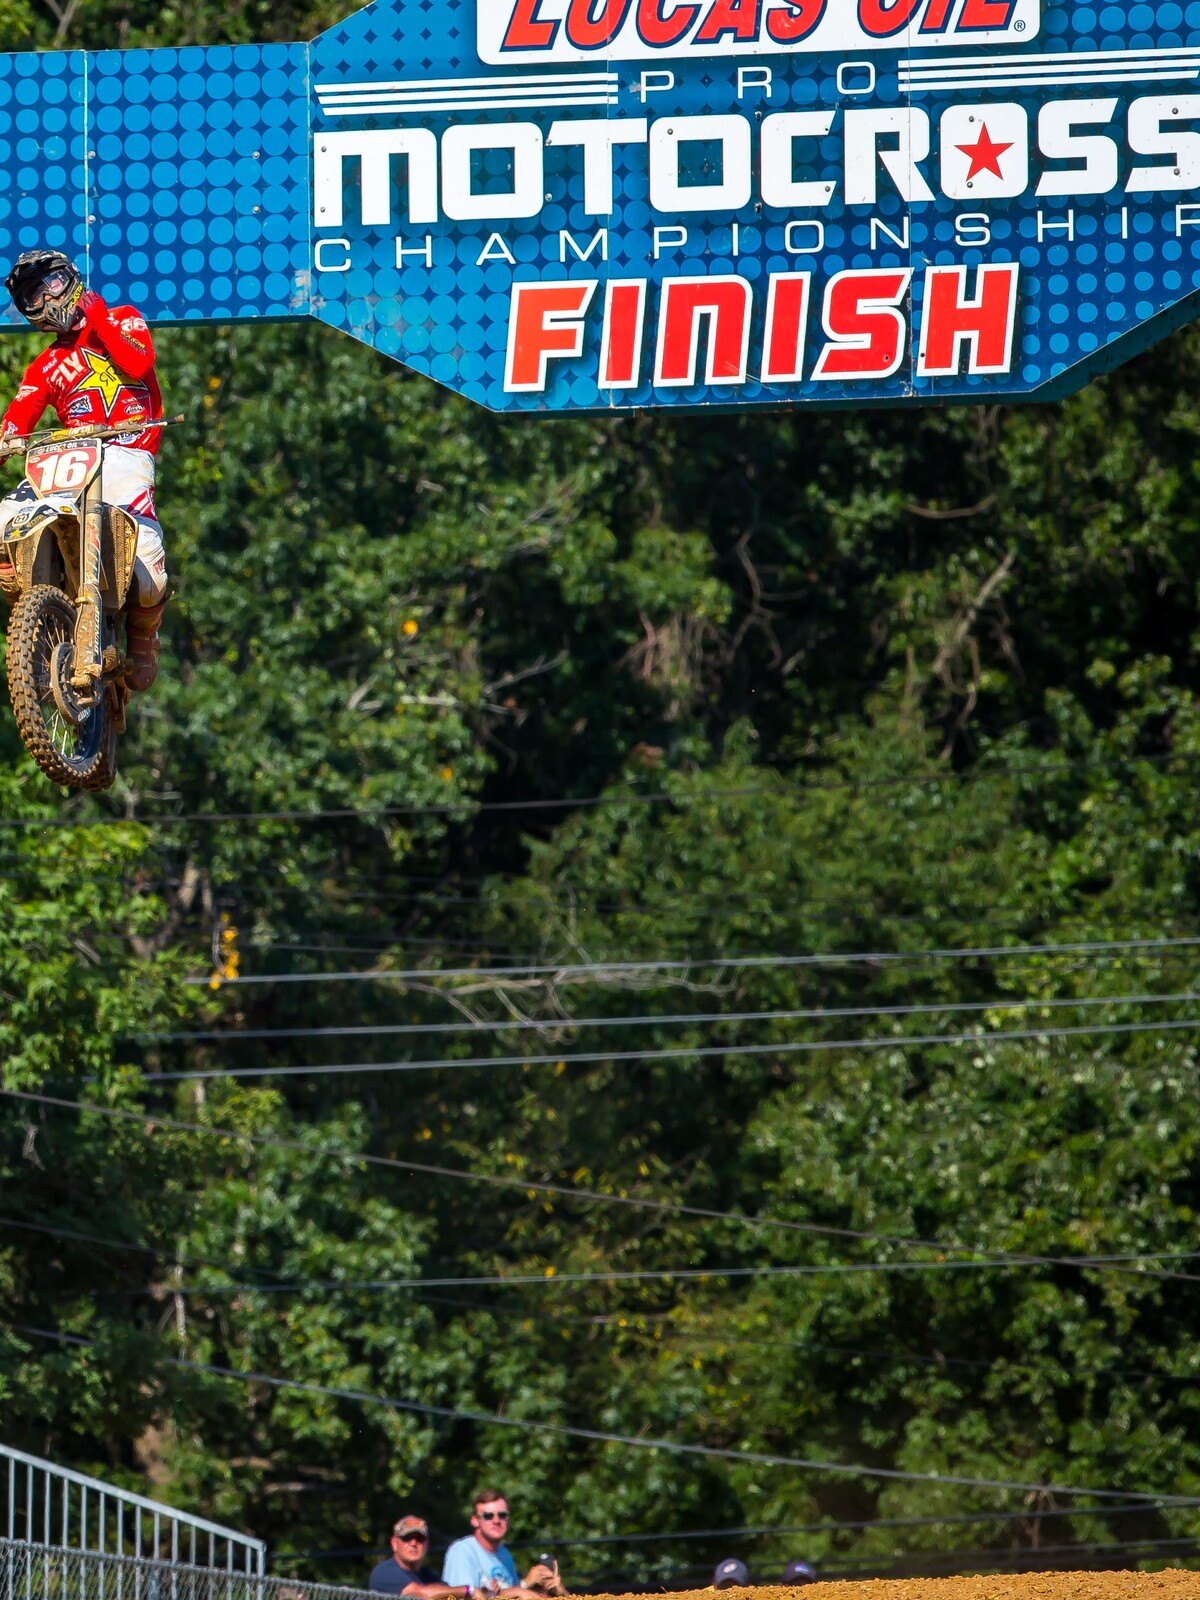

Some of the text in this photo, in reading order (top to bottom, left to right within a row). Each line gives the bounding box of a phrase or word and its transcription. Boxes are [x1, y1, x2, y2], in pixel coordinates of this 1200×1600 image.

[500, 0, 1019, 52] LUCAS OIL
[640, 61, 877, 103] PRO
[313, 94, 1200, 228] MOTOCROSS
[313, 204, 1200, 272] CHAMPIONSHIP
[503, 262, 1020, 393] FINISH
[36, 450, 90, 491] 16
